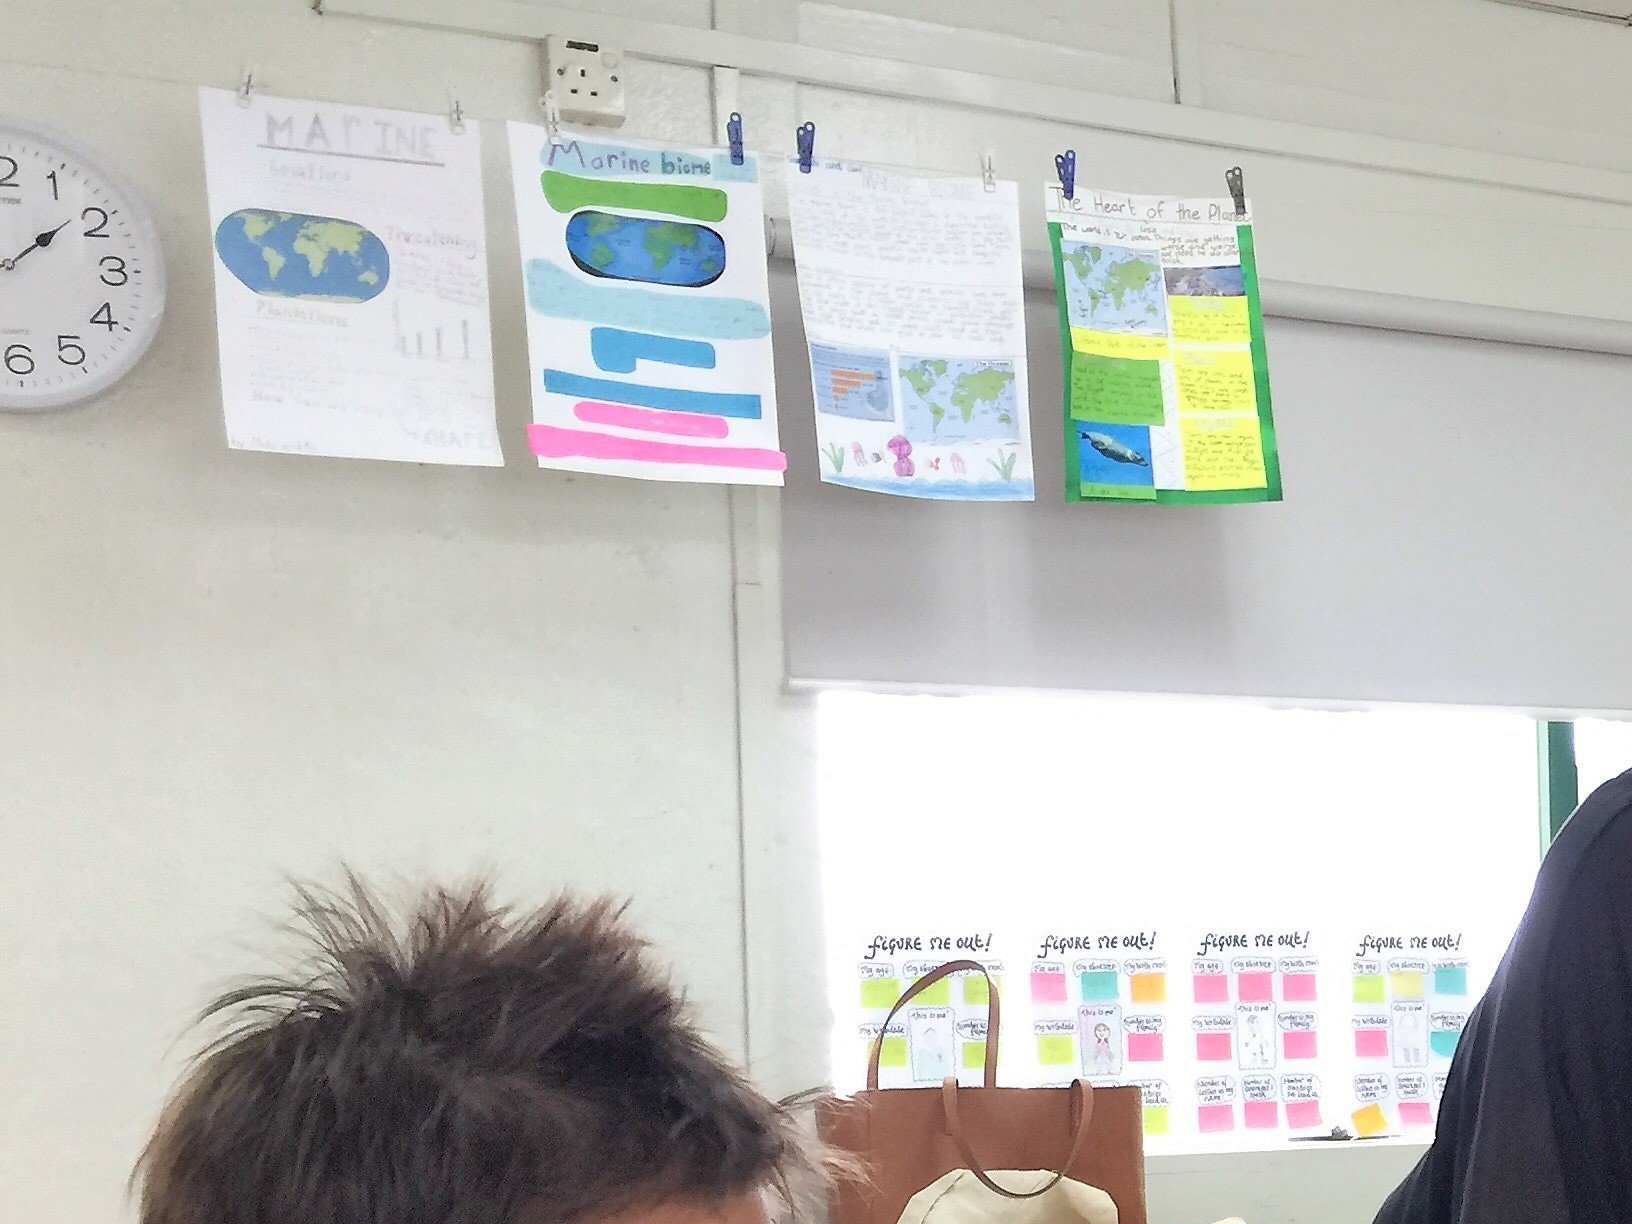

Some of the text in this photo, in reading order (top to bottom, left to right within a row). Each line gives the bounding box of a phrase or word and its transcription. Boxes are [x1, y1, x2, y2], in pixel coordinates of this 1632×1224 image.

[547, 140, 712, 176] Marine biome
[47, 170, 59, 201] 1
[81, 206, 110, 238] 2
[1093, 195, 1137, 216] Heart
[1146, 200, 1165, 219] of
[1176, 202, 1201, 220] the
[99, 255, 128, 286] 3
[89, 301, 119, 332] 4
[3, 344, 35, 375] 6
[57, 334, 86, 366] 5
[929, 936, 951, 951] ME
[1097, 935, 1118, 949] ME
[1254, 934, 1273, 947] ME
[1409, 936, 1428, 949] ME
